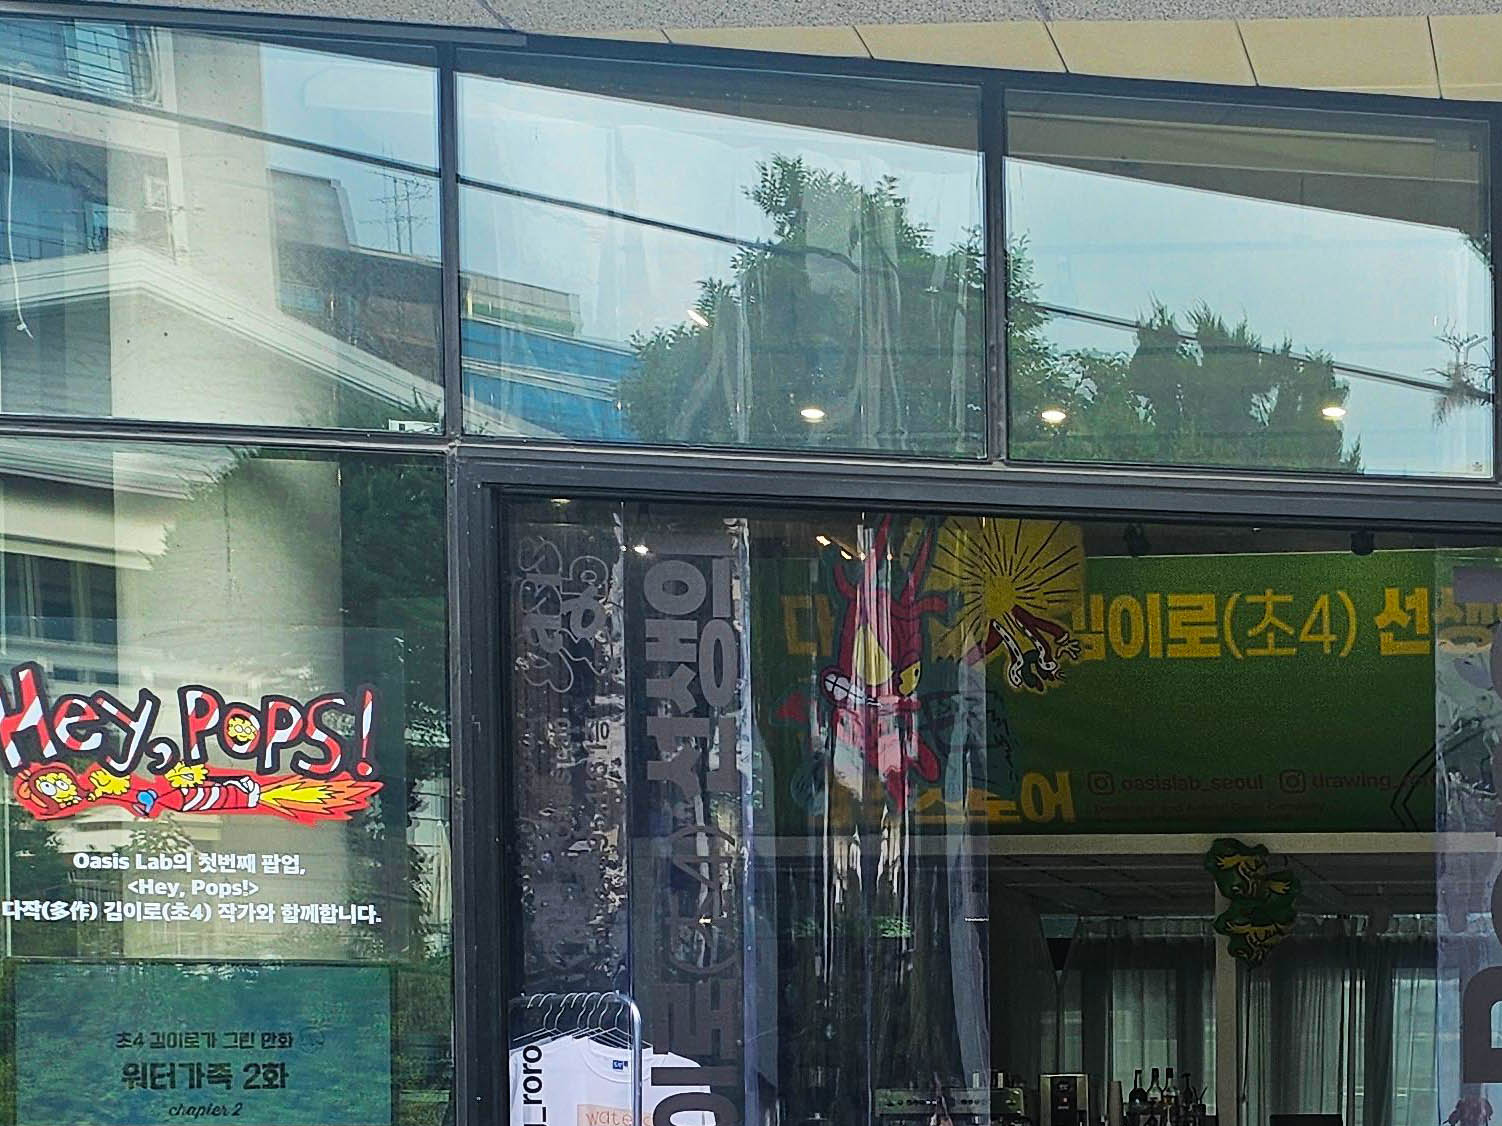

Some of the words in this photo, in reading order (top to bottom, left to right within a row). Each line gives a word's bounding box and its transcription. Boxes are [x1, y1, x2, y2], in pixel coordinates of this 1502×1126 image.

[643, 532, 738, 796] 선생의
[0, 660, 180, 777] Hey,
[73, 852, 130, 869] Oasis
[135, 852, 192, 873] Lab의
[199, 852, 257, 873] 첫번째
[261, 854, 307, 875] 팝업,
[128, 878, 186, 898] <Hey,
[191, 879, 259, 898] Pops!>
[2, 899, 98, 921] 다작(多作)
[103, 901, 212, 922] 김이로(초4)
[217, 902, 276, 923] 작가와
[280, 903, 383, 925] 함께합니다.
[116, 1032, 145, 1049] 초4
[149, 1031, 218, 1050] 김이로가
[222, 1032, 255, 1050] 그린
[260, 1032, 295, 1050] 만화
[121, 1062, 233, 1091] 워터가족
[242, 1062, 290, 1091] 2화
[231, 1103, 244, 1117] 2
